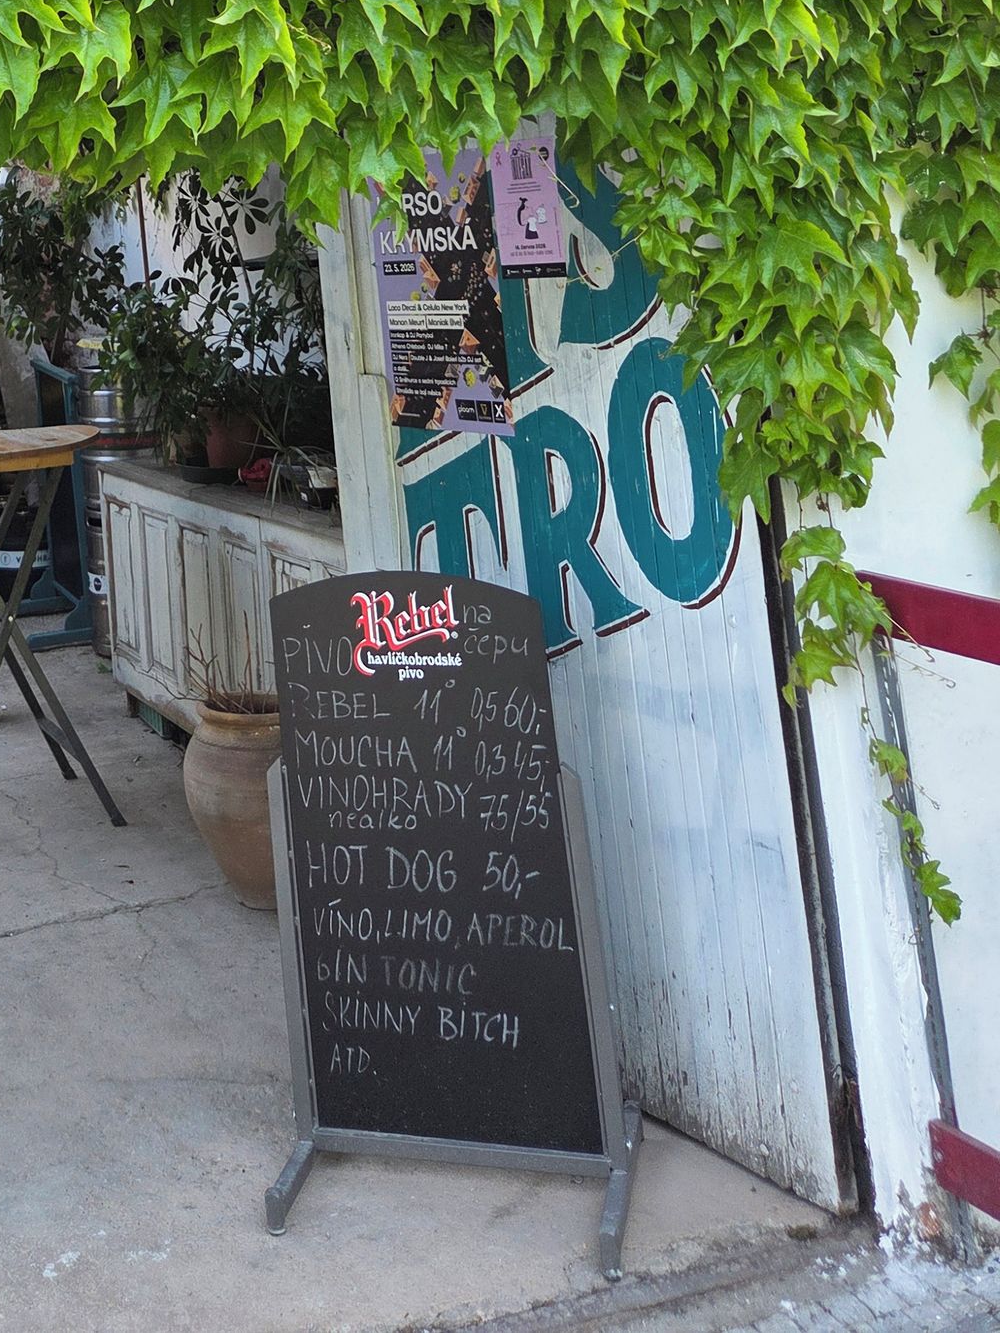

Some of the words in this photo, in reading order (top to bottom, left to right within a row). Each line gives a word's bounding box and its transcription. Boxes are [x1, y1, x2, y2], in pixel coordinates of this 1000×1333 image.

[400, 263, 415, 272] 2026
[351, 585, 459, 651] Rebel
[462, 604, 492, 624] na
[463, 627, 528, 663] čepu
[398, 668, 425, 680] pivo
[288, 682, 390, 719] REBEL
[295, 729, 418, 773] MOUCHA
[297, 774, 473, 819] VINOHRADY
[329, 809, 417, 829] nealko
[306, 840, 368, 888] HOT
[385, 846, 457, 893] DOG
[467, 912, 574, 951] APEROL
[380, 955, 477, 995] TONIC
[322, 990, 421, 1035] SKINNY
[437, 1002, 519, 1048] BITCH
[330, 1043, 378, 1075] ATD.
